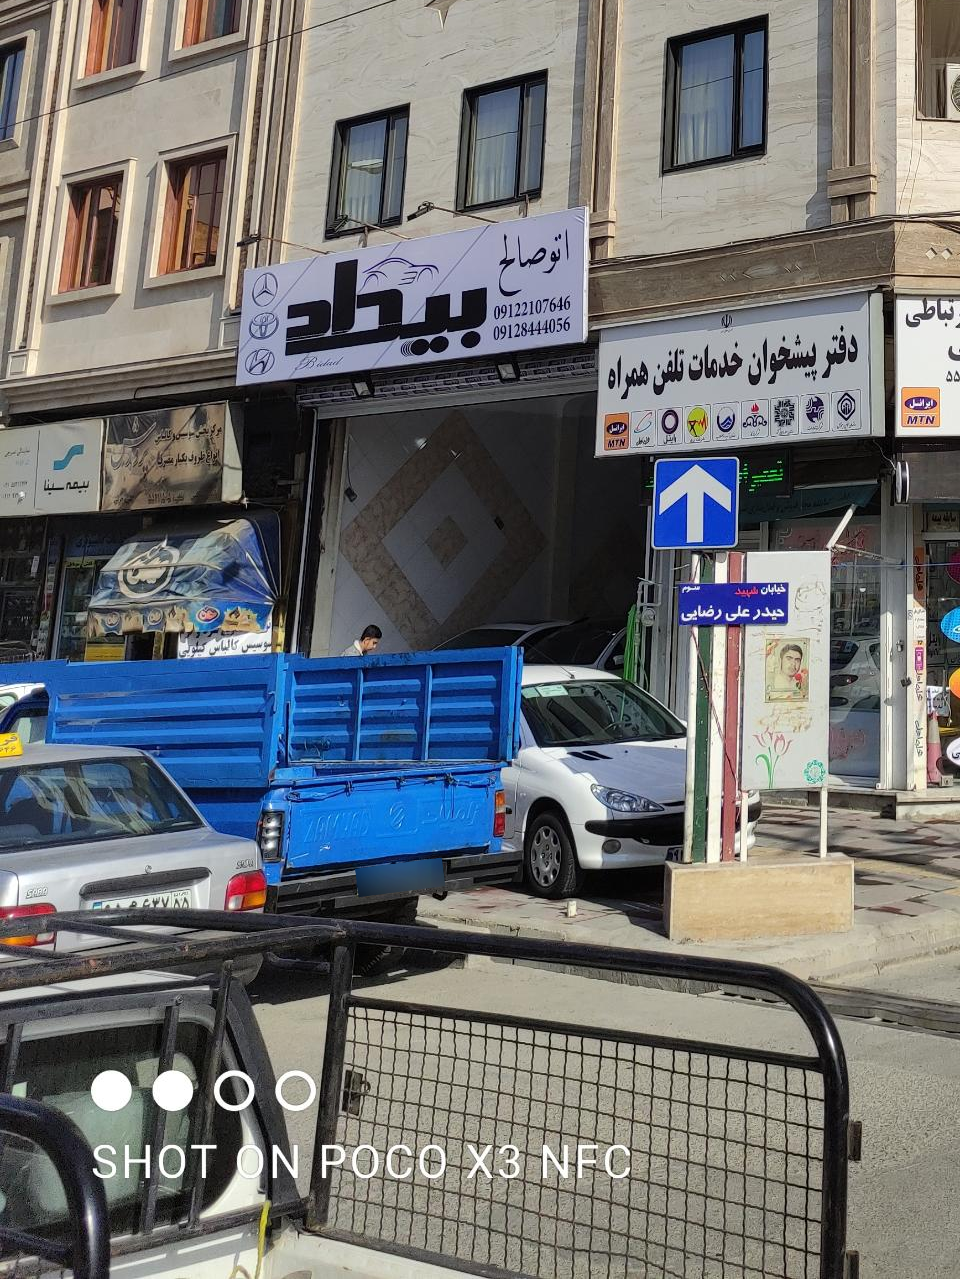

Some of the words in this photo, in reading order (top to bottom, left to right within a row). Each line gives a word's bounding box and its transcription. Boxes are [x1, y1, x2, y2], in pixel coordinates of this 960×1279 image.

[543, 229, 569, 274] اتو
[498, 234, 546, 297] صالح
[493, 296, 571, 320] 09122107646
[493, 318, 571, 341] 09128444056
[748, 334, 817, 386] پیشخوان
[822, 325, 859, 379] دفتر
[688, 341, 743, 382] خدمات
[607, 356, 649, 400] همراه
[653, 347, 684, 396] تلفن
[908, 398, 935, 409] ایرانسل
[906, 415, 936, 425] MTN
[608, 439, 626, 448] MTN
[66, 480, 90, 493] بیمه
[681, 585, 701, 594] سوم
[734, 585, 759, 598] شهید
[760, 583, 786, 595] خیابان
[681, 605, 722, 621] رضایی
[725, 605, 750, 621] علی
[752, 607, 785, 620] حیدر
[209, 638, 239, 655] کالباس
